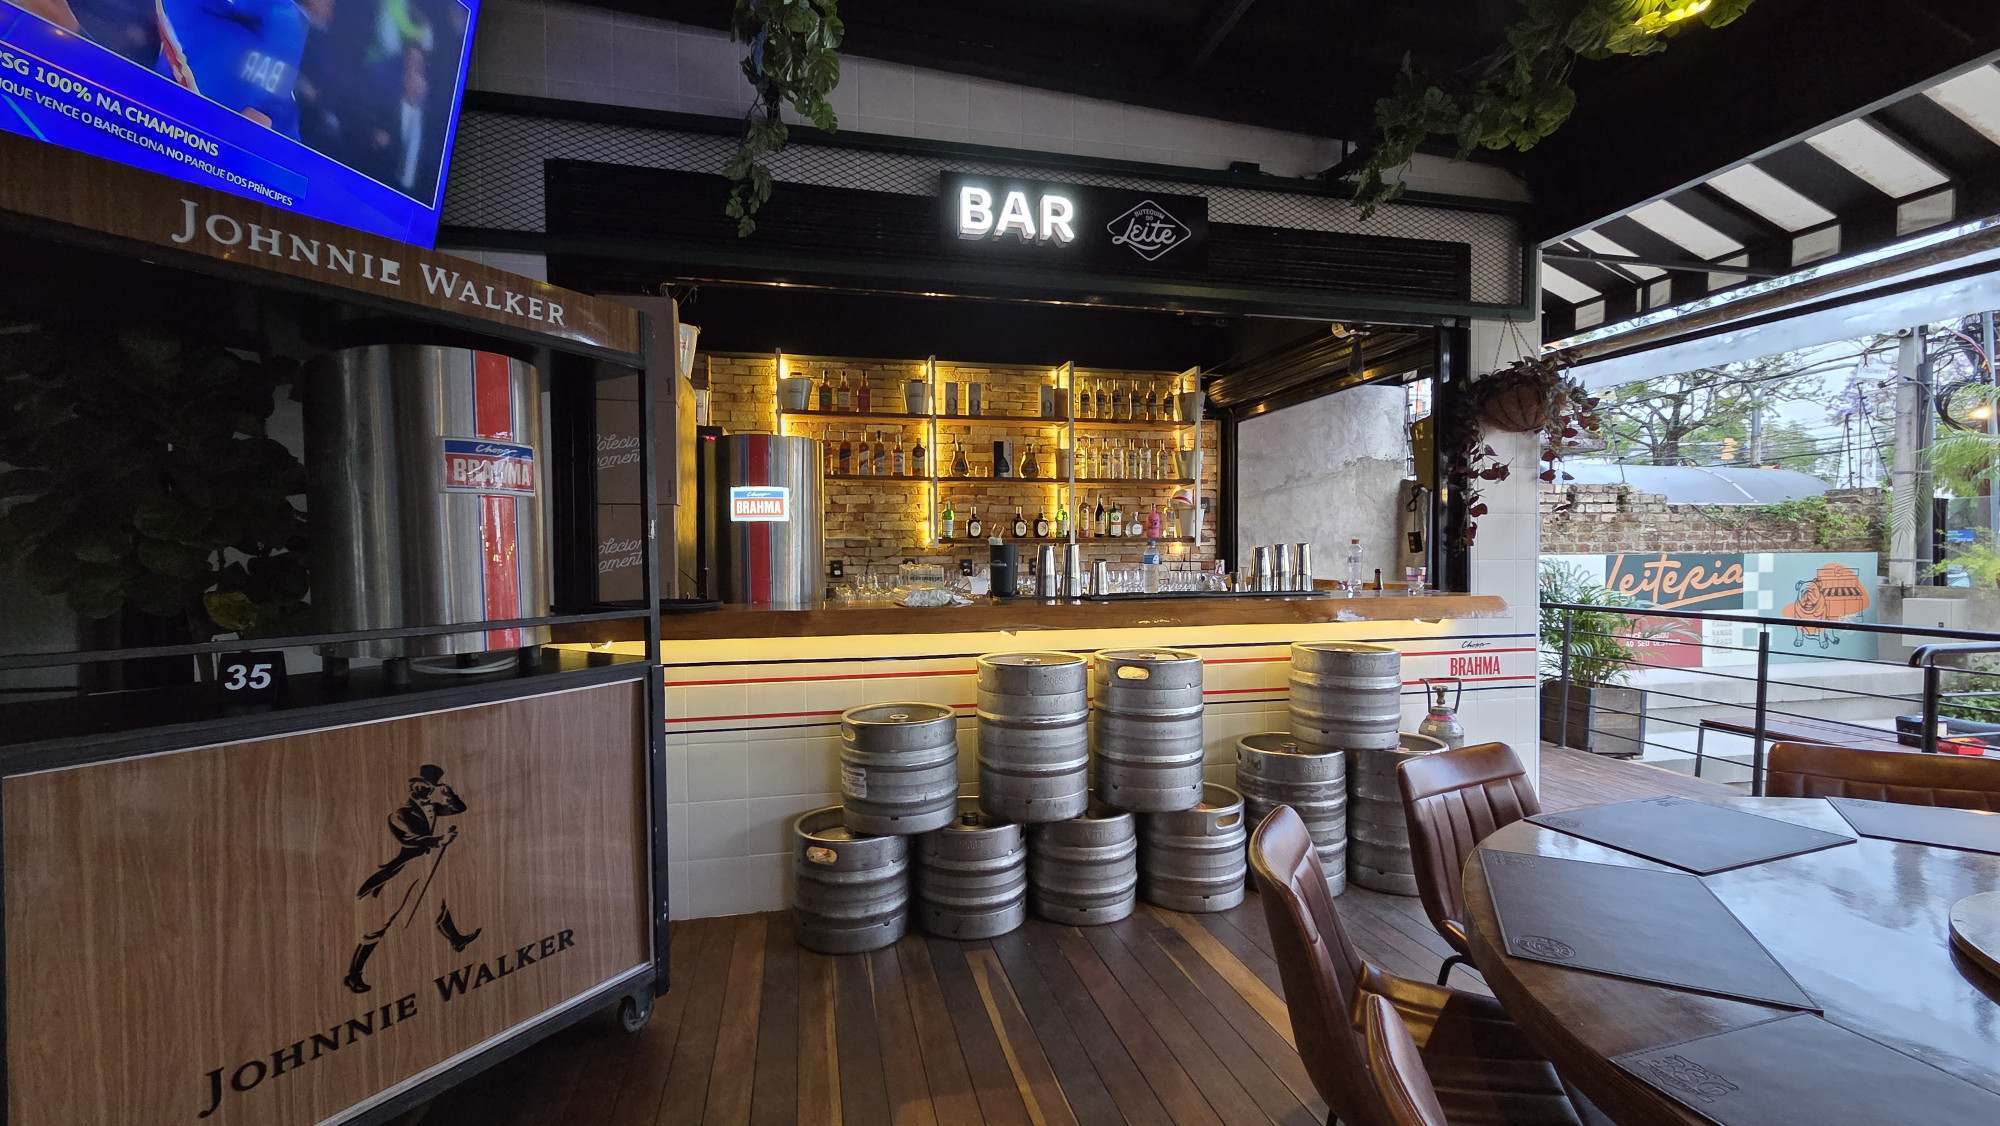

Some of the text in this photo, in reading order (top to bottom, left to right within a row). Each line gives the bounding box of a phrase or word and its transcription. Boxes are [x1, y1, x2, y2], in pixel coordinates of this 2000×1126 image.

[35, 66, 92, 102] 100%
[96, 92, 122, 116] NA
[125, 106, 219, 157] CHAMPIONS
[35, 92, 80, 119] VENCE
[81, 112, 92, 124] O
[93, 116, 165, 154] BARCELONA
[166, 146, 184, 162] NO
[184, 154, 226, 180] PARQUE
[226, 170, 247, 188] DOS
[247, 179, 294, 207] PRÍNCIPES
[959, 186, 1075, 243] BAR
[1112, 217, 1176, 251] Leite
[171, 198, 567, 327] JOHNNIE WALKER
[736, 500, 782, 515] BRAHMA
[224, 663, 272, 690] 35
[1449, 655, 1501, 677] BRAHMA
[198, 928, 575, 1119] JOHNNIE WALKER
